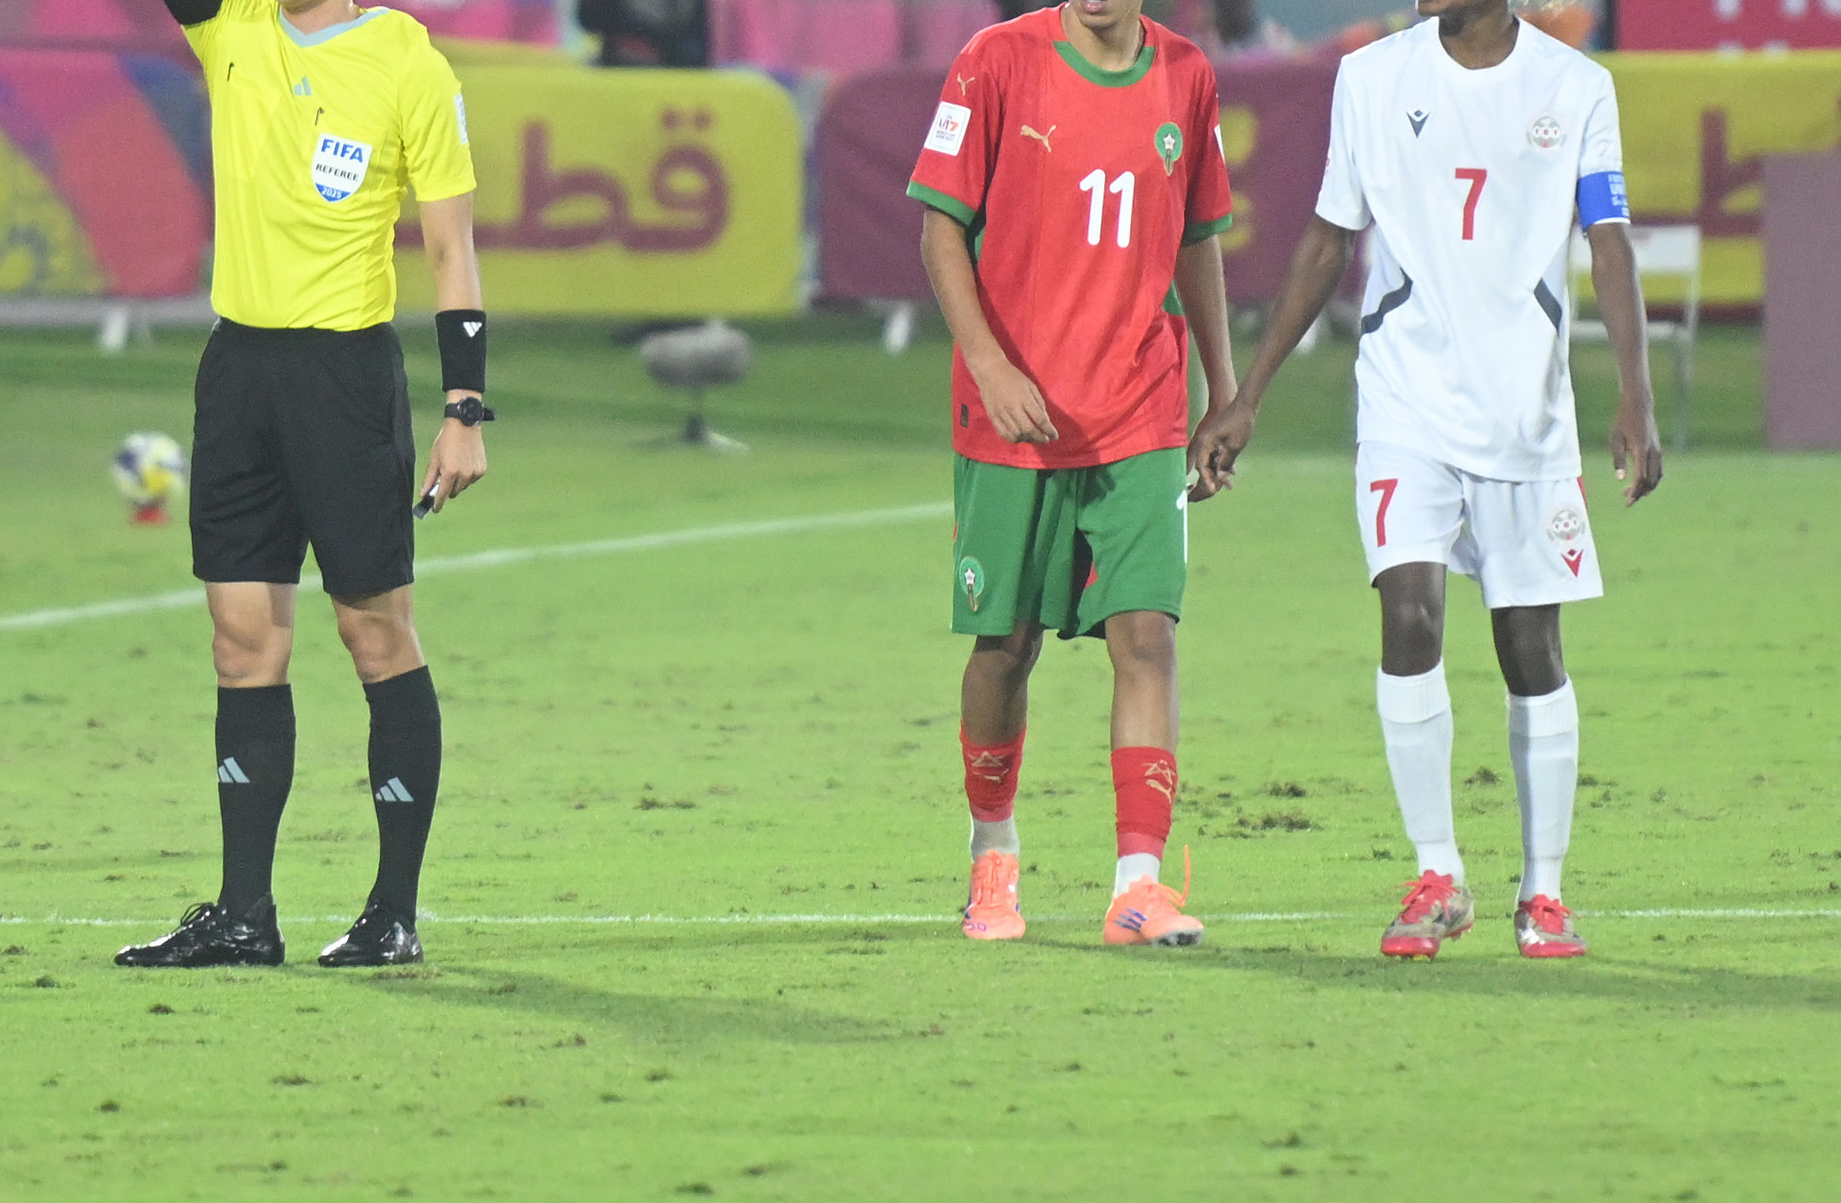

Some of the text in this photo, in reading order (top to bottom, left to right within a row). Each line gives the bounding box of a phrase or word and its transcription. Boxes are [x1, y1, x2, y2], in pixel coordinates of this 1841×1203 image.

[315, 163, 359, 182] REFEREE
[321, 138, 363, 163] FIFA
[322, 187, 343, 199] 2025
[1079, 168, 1135, 248] 11
[1455, 167, 1487, 240] 7
[1370, 478, 1398, 548] 7
